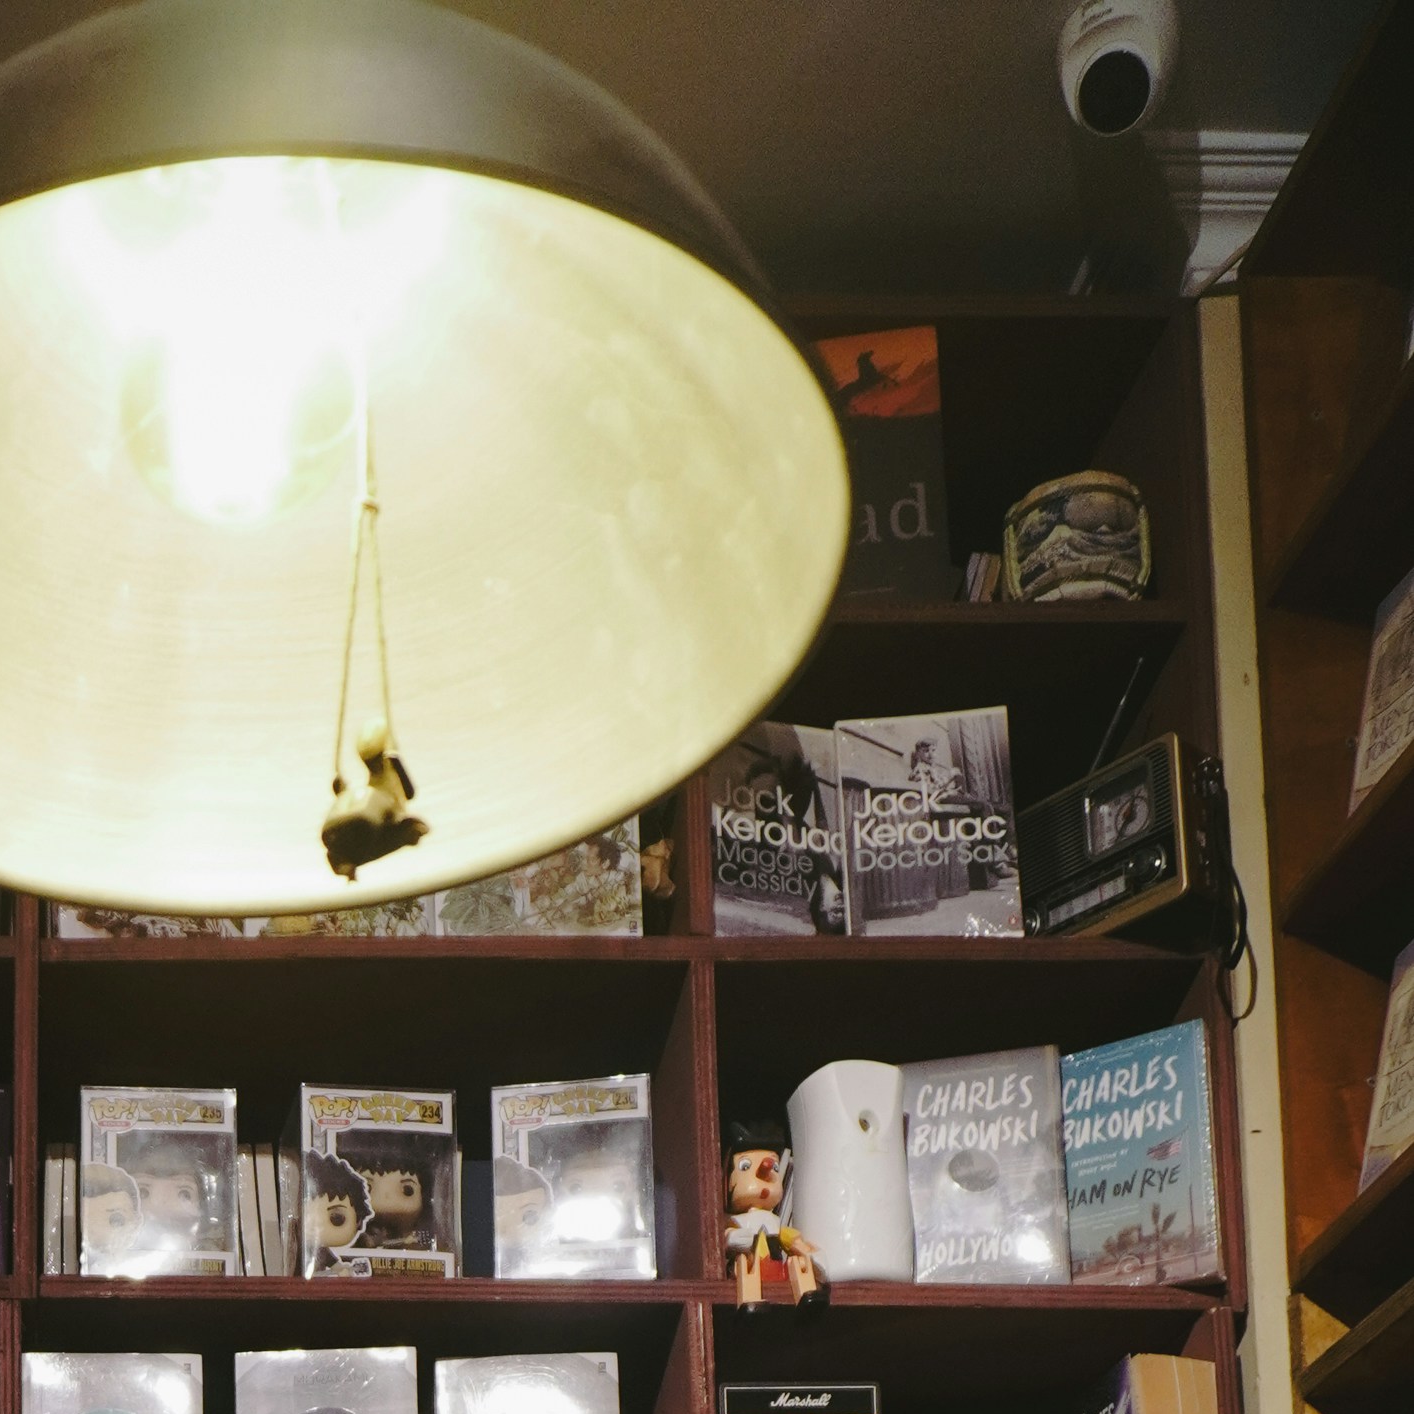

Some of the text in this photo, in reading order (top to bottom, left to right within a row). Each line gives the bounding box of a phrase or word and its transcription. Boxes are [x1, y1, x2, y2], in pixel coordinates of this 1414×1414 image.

[718, 780, 795, 818] Jack
[853, 785, 944, 821] Jack
[852, 813, 1008, 850] Kerouac
[715, 840, 815, 876] Maggie
[854, 839, 1011, 873] Doctor Sax
[717, 865, 818, 903] Cassidy
[915, 1072, 1035, 1118] CHARLES
[1062, 1054, 1179, 1113] CHARLES
[420, 1104, 441, 1120] 234
[913, 1109, 1039, 1158] BUKOWSKI
[1140, 1163, 1183, 1191] RYE
[769, 1391, 833, 1409] Marshall
